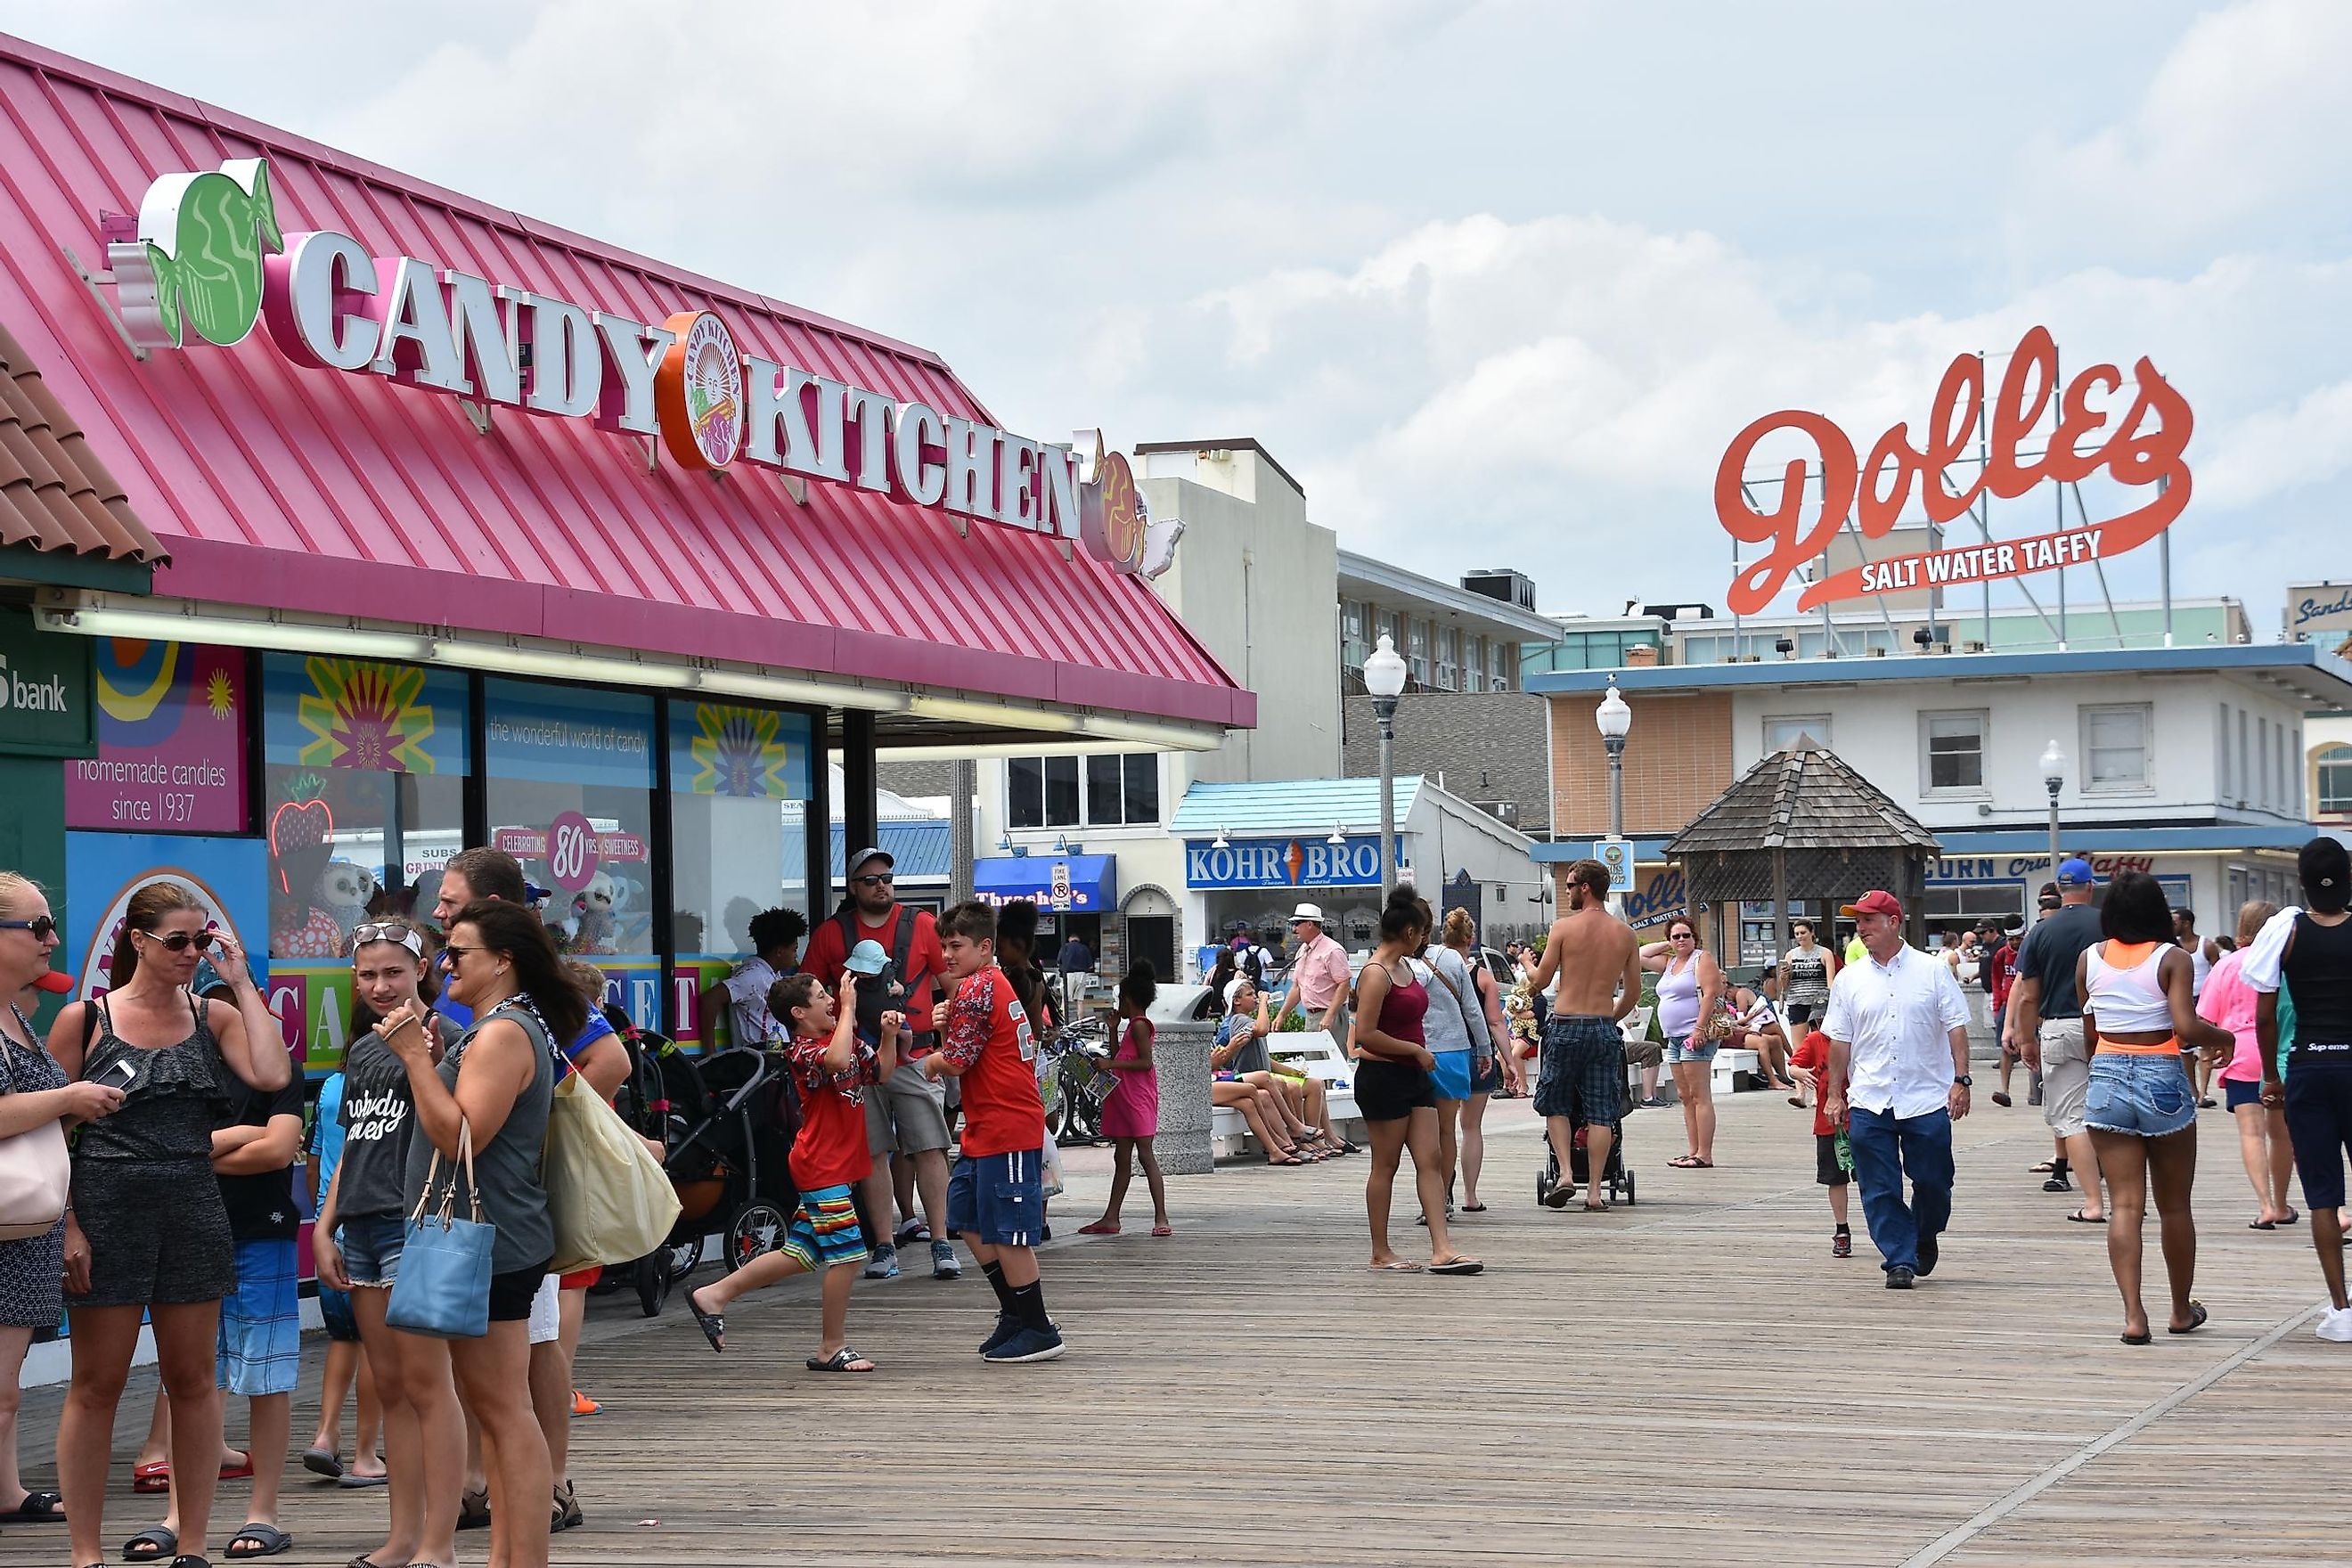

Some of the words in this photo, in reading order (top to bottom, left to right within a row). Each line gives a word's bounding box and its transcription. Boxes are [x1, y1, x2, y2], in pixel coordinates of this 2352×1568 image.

[285, 229, 676, 436] CANDY
[685, 319, 706, 381] CANDY
[742, 354, 1084, 540] KITCHEN
[1860, 558, 1922, 593] SALT
[1924, 543, 2016, 584] WATER
[2020, 529, 2103, 570] TAFFY
[12, 670, 68, 713] bank
[489, 715, 509, 741] the
[511, 721, 568, 747] wonderful
[571, 727, 601, 750] world
[604, 727, 616, 751] of
[78, 756, 167, 785] homemade
[172, 758, 226, 788] candies
[112, 791, 151, 821] since
[158, 793, 195, 822] 1937
[421, 848, 457, 858] SUBS
[502, 834, 546, 853] CELEBRATING
[552, 824, 584, 878] 80
[604, 839, 640, 856] SWEETNESS
[1188, 847, 1283, 882] KOHR
[1632, 918, 1651, 930] SALT
[1650, 911, 1679, 925] WATER
